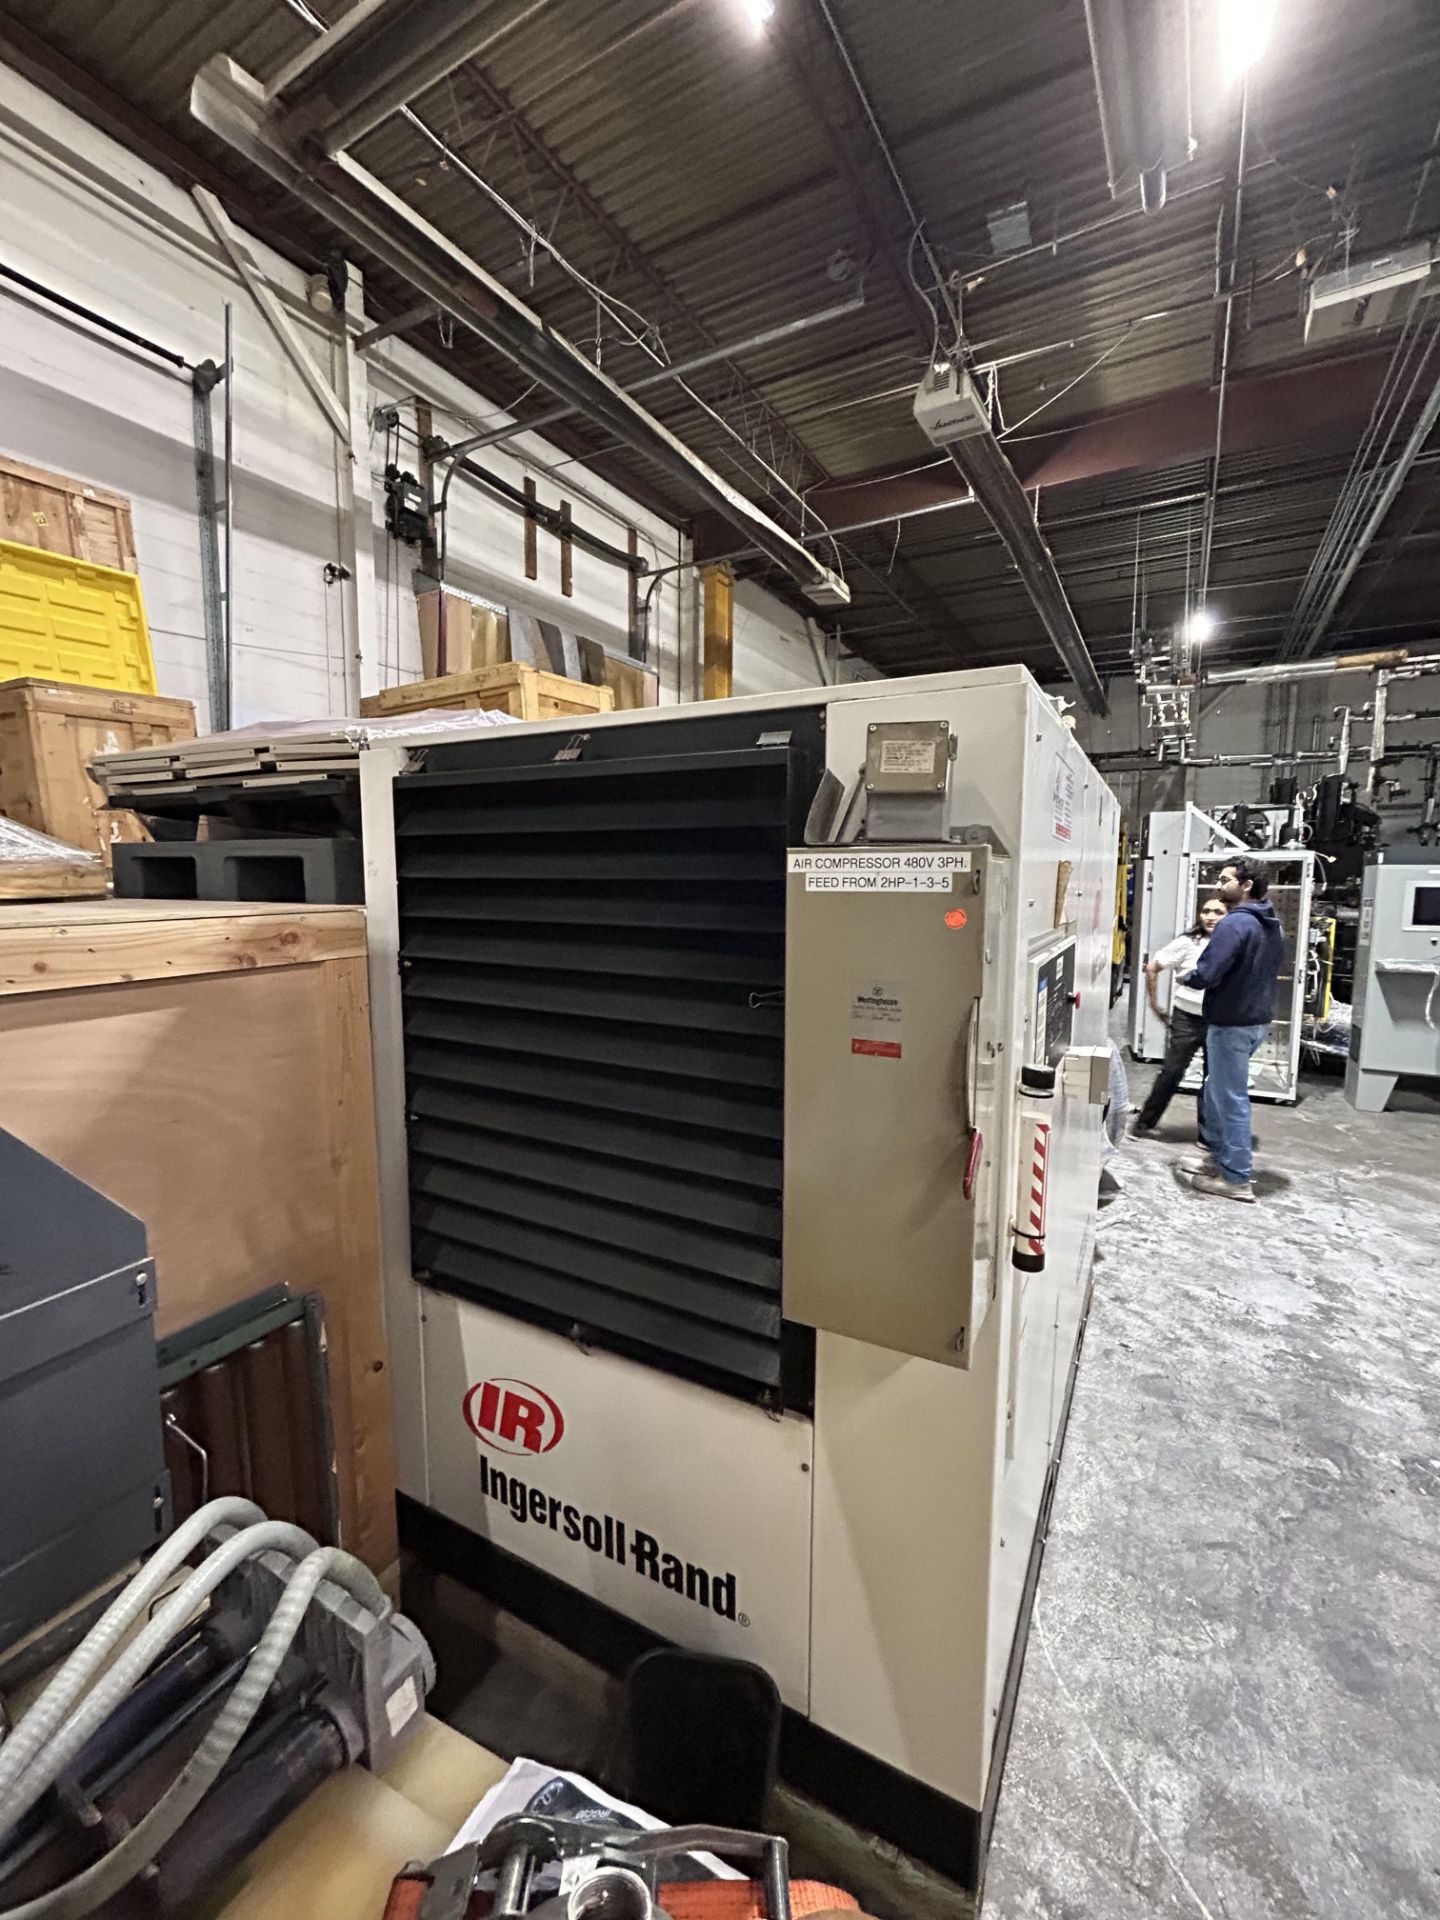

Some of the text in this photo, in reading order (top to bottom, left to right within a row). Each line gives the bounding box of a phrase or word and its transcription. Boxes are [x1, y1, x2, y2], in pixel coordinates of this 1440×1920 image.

[793, 856, 968, 869] AIR COMPRESSOR 480V 3PH.
[808, 877, 950, 888] FEED FROM 2HP-1-3-5
[478, 1381, 546, 1454] IR
